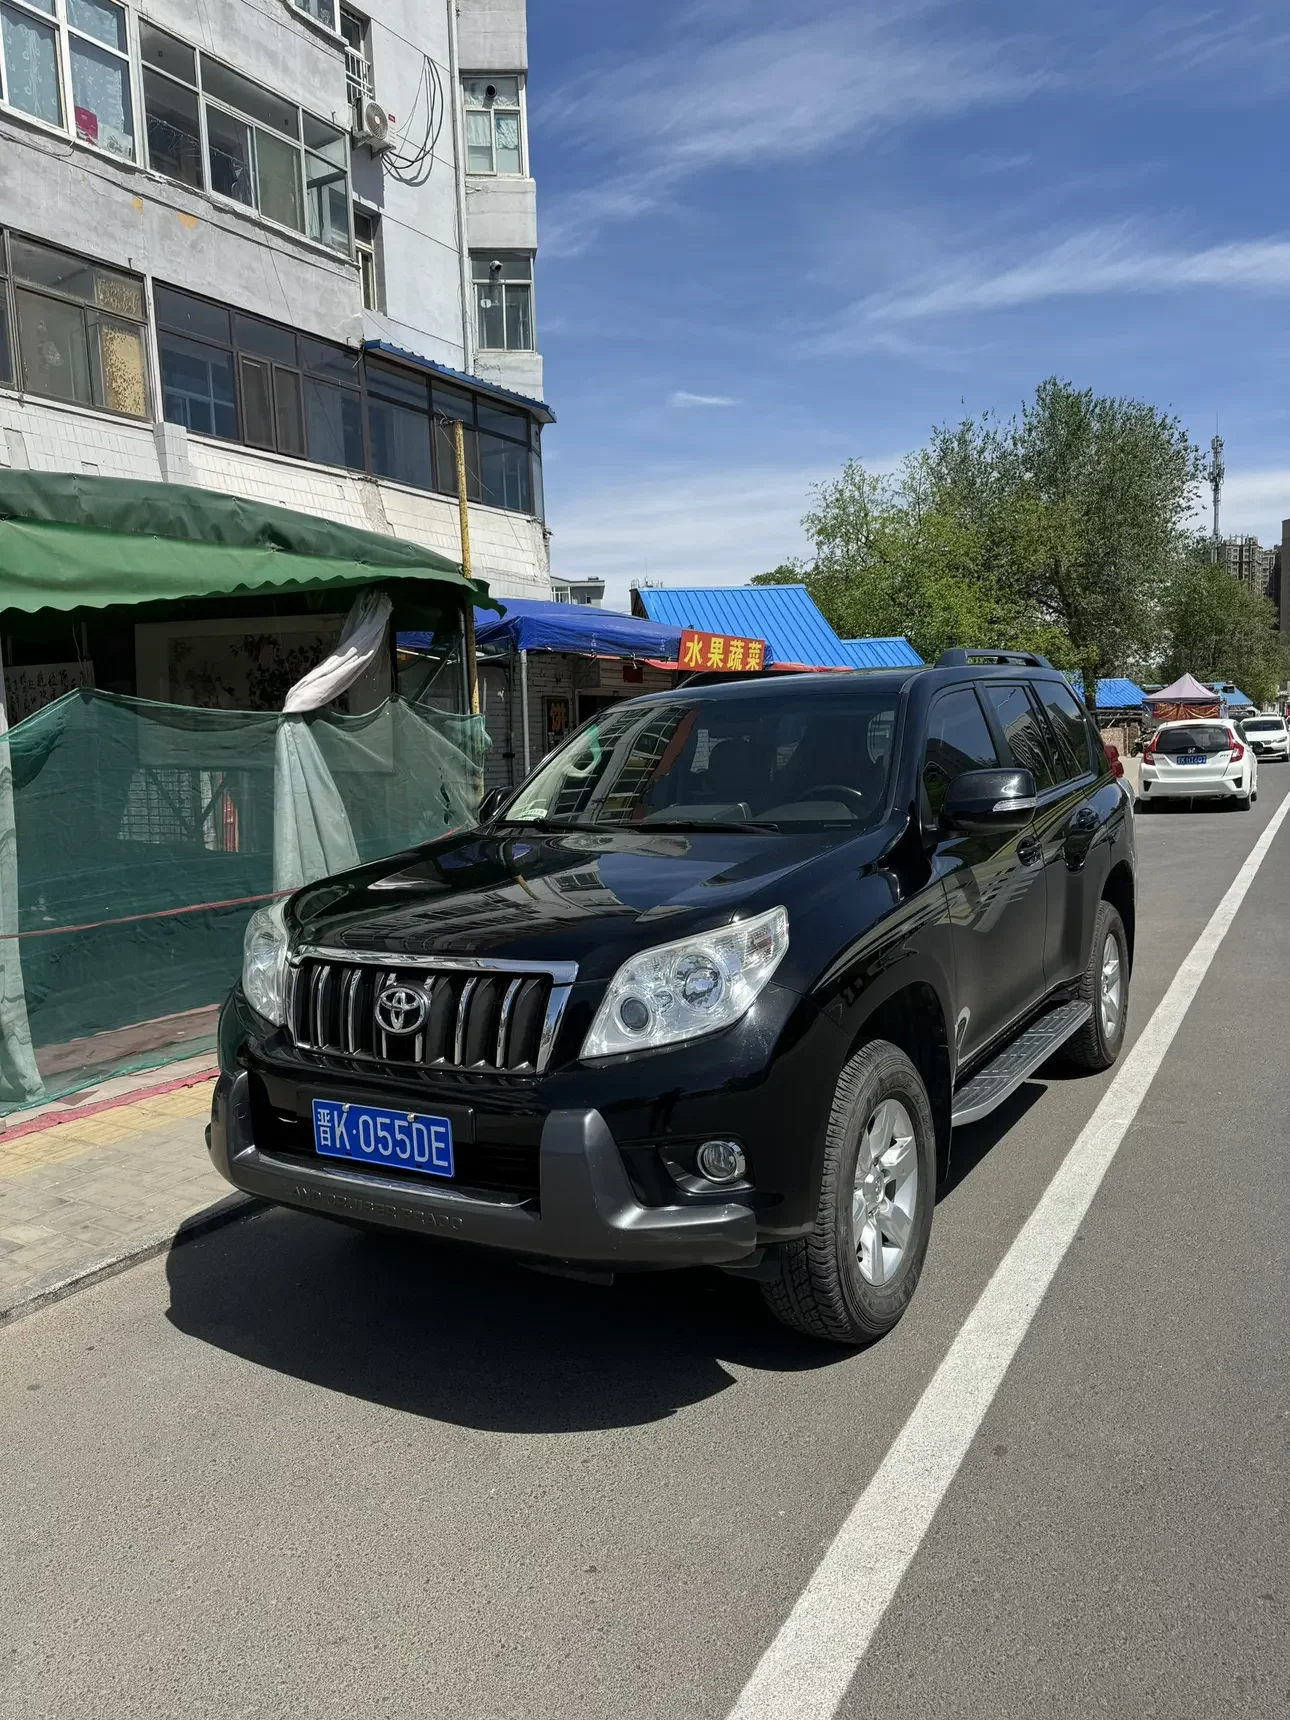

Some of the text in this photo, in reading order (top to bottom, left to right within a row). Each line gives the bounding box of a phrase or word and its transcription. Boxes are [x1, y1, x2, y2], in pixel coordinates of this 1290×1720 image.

[684, 634, 762, 671] 水果蔬菜
[401, 1208, 463, 1229] PRADO
